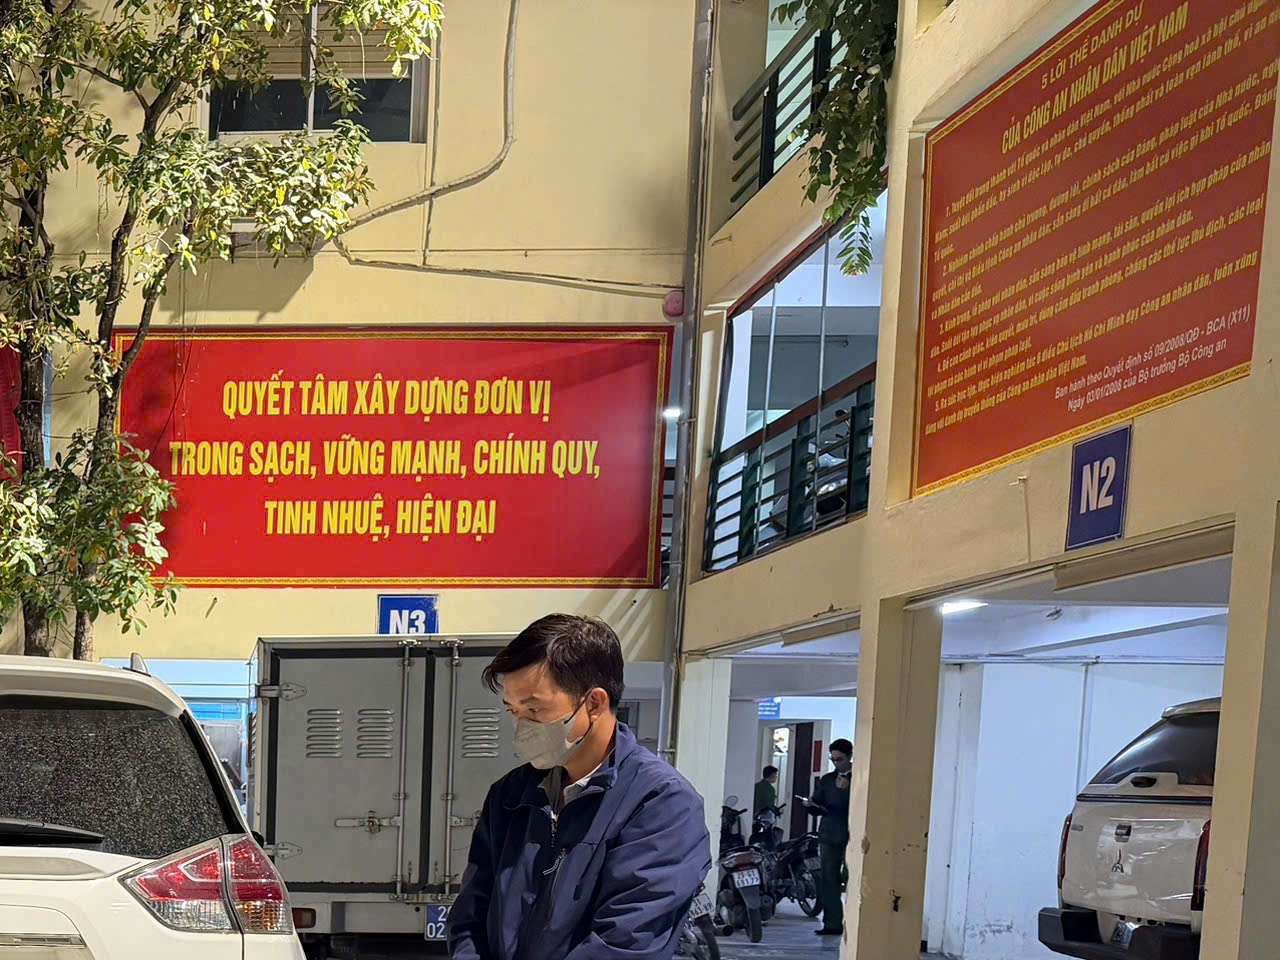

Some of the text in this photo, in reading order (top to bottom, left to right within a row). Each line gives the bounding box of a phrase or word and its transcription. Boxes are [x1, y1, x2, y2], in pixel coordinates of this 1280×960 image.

[1001, 0, 1188, 155] CỦA CÔNG AN NHÂN DÂN VIỆT NAM
[1041, 72, 1047, 90] 5
[1050, 52, 1066, 84] LỜI
[1069, 34, 1088, 70] THỀ
[1090, 15, 1122, 54] DANH
[1206, 315, 1226, 336] BCA
[1227, 303, 1250, 329] (X11)
[1177, 351, 1189, 371] Bộ
[1191, 341, 1213, 364] Công
[1215, 338, 1226, 352] an
[223, 369, 552, 423] QUYẾT TÂM XÂY DỰNG ĐƠN VỊ
[169, 432, 601, 483] TRONG SẠCH, VỮNG MẠNH, CHÍNH QUY,
[1079, 456, 1117, 515] N2
[264, 492, 497, 543] TINH NHUỆ, HIỆN ĐẠI
[389, 609, 426, 634] N3
